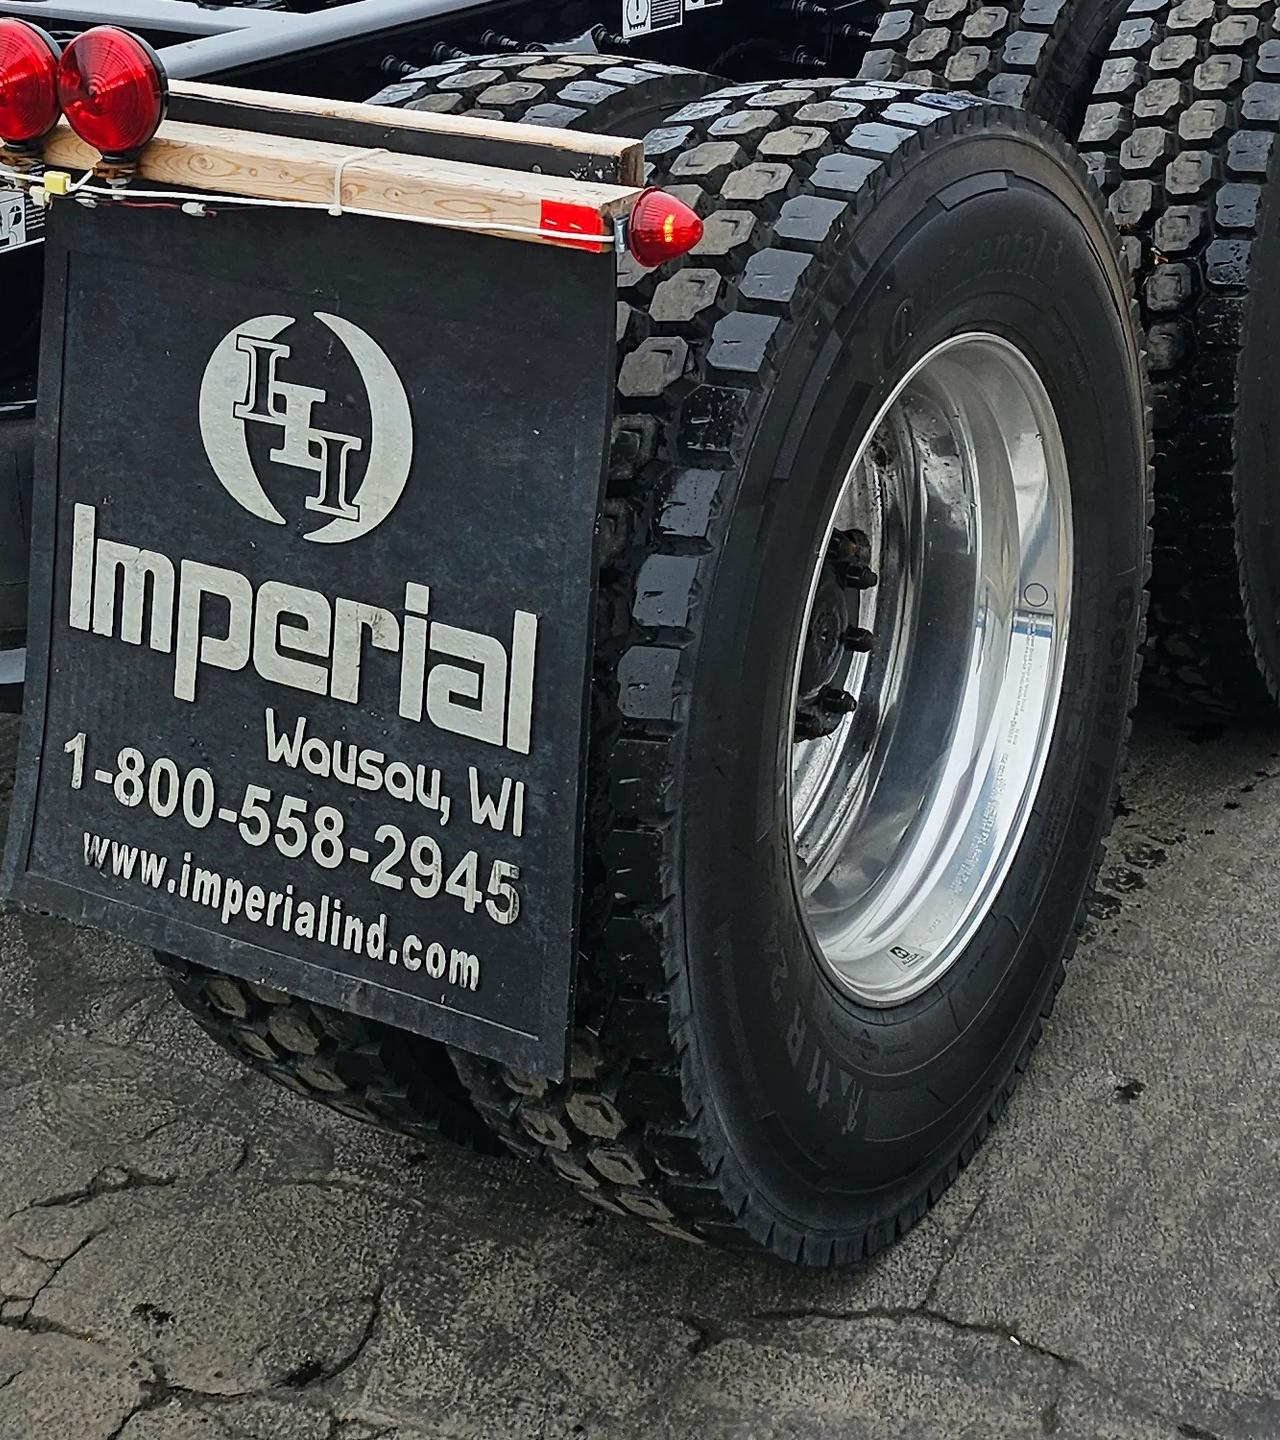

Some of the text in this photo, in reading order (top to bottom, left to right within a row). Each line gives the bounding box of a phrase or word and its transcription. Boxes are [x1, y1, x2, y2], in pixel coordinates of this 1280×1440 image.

[68, 502, 539, 755] Imperial
[63, 731, 521, 926] 1-800-558-2945
[264, 707, 526, 837] Wausau, WI
[82, 825, 482, 993] www.imperialind.com
